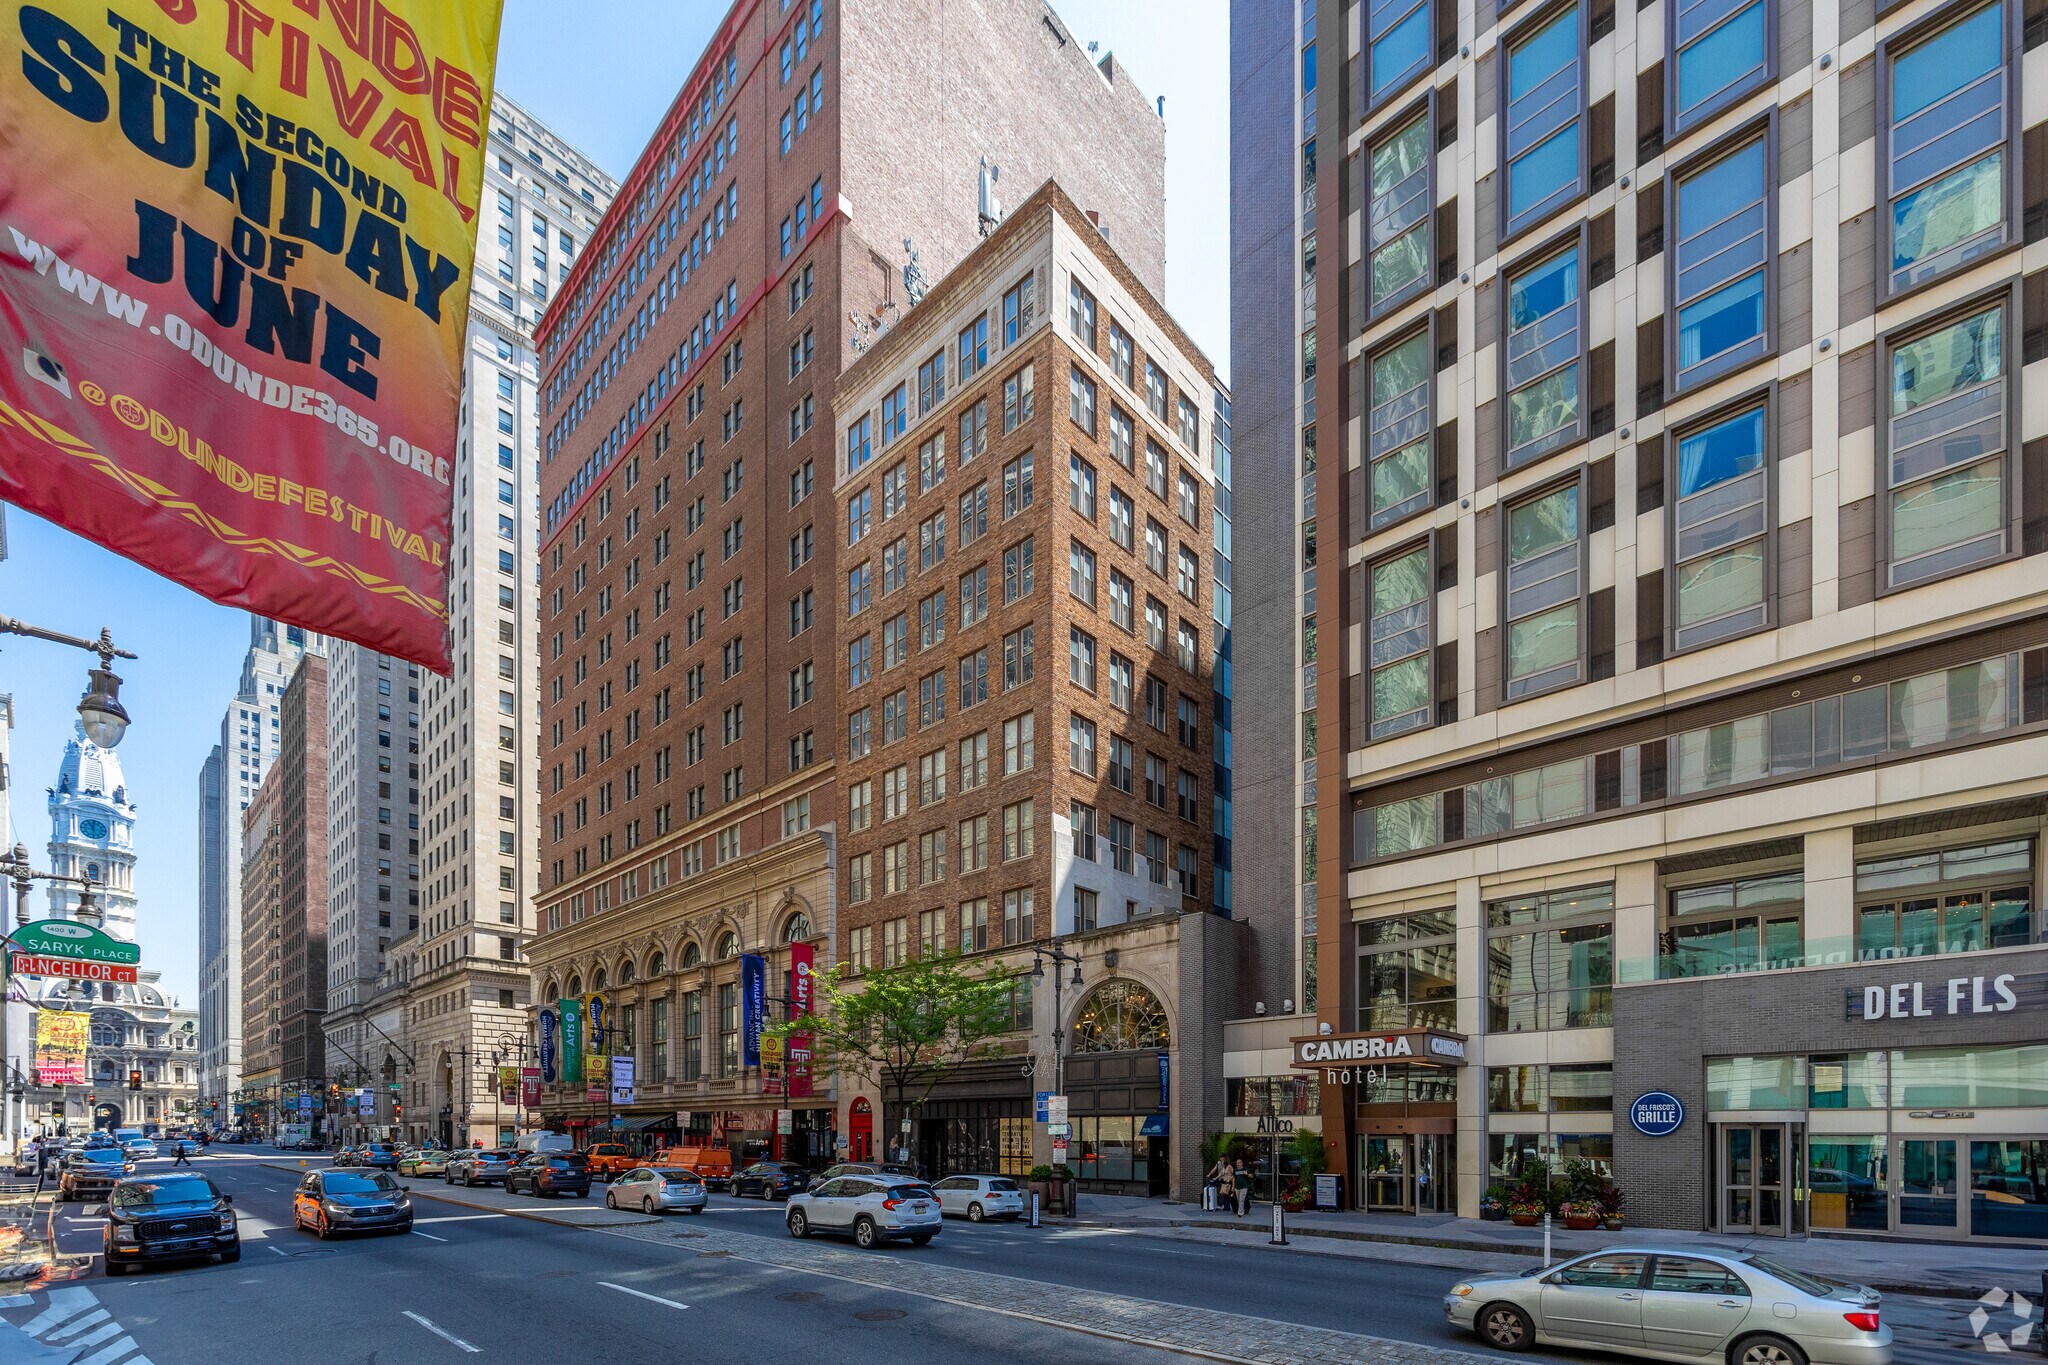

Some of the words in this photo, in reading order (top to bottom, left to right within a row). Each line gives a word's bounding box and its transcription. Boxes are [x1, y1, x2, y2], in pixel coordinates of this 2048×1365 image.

[107, 8, 221, 110] THE
[235, 94, 407, 224] SECOND
[20, 5, 459, 324] SUNDAY
[232, 216, 304, 280] OF
[127, 199, 381, 401] JUNE
[28, 939, 85, 955] SARYK
[93, 949, 132, 960] PLACE
[12, 955, 111, 980] NCELLOR
[117, 971, 131, 982] CT
[1864, 982, 1932, 1020] DEL
[1947, 973, 2017, 1015] FLS
[566, 1024, 575, 1046] Arts
[1327, 1064, 1387, 1085] hotel
[1637, 1111, 1676, 1123] GRILLE
[286, 1127, 308, 1135] FedEx
